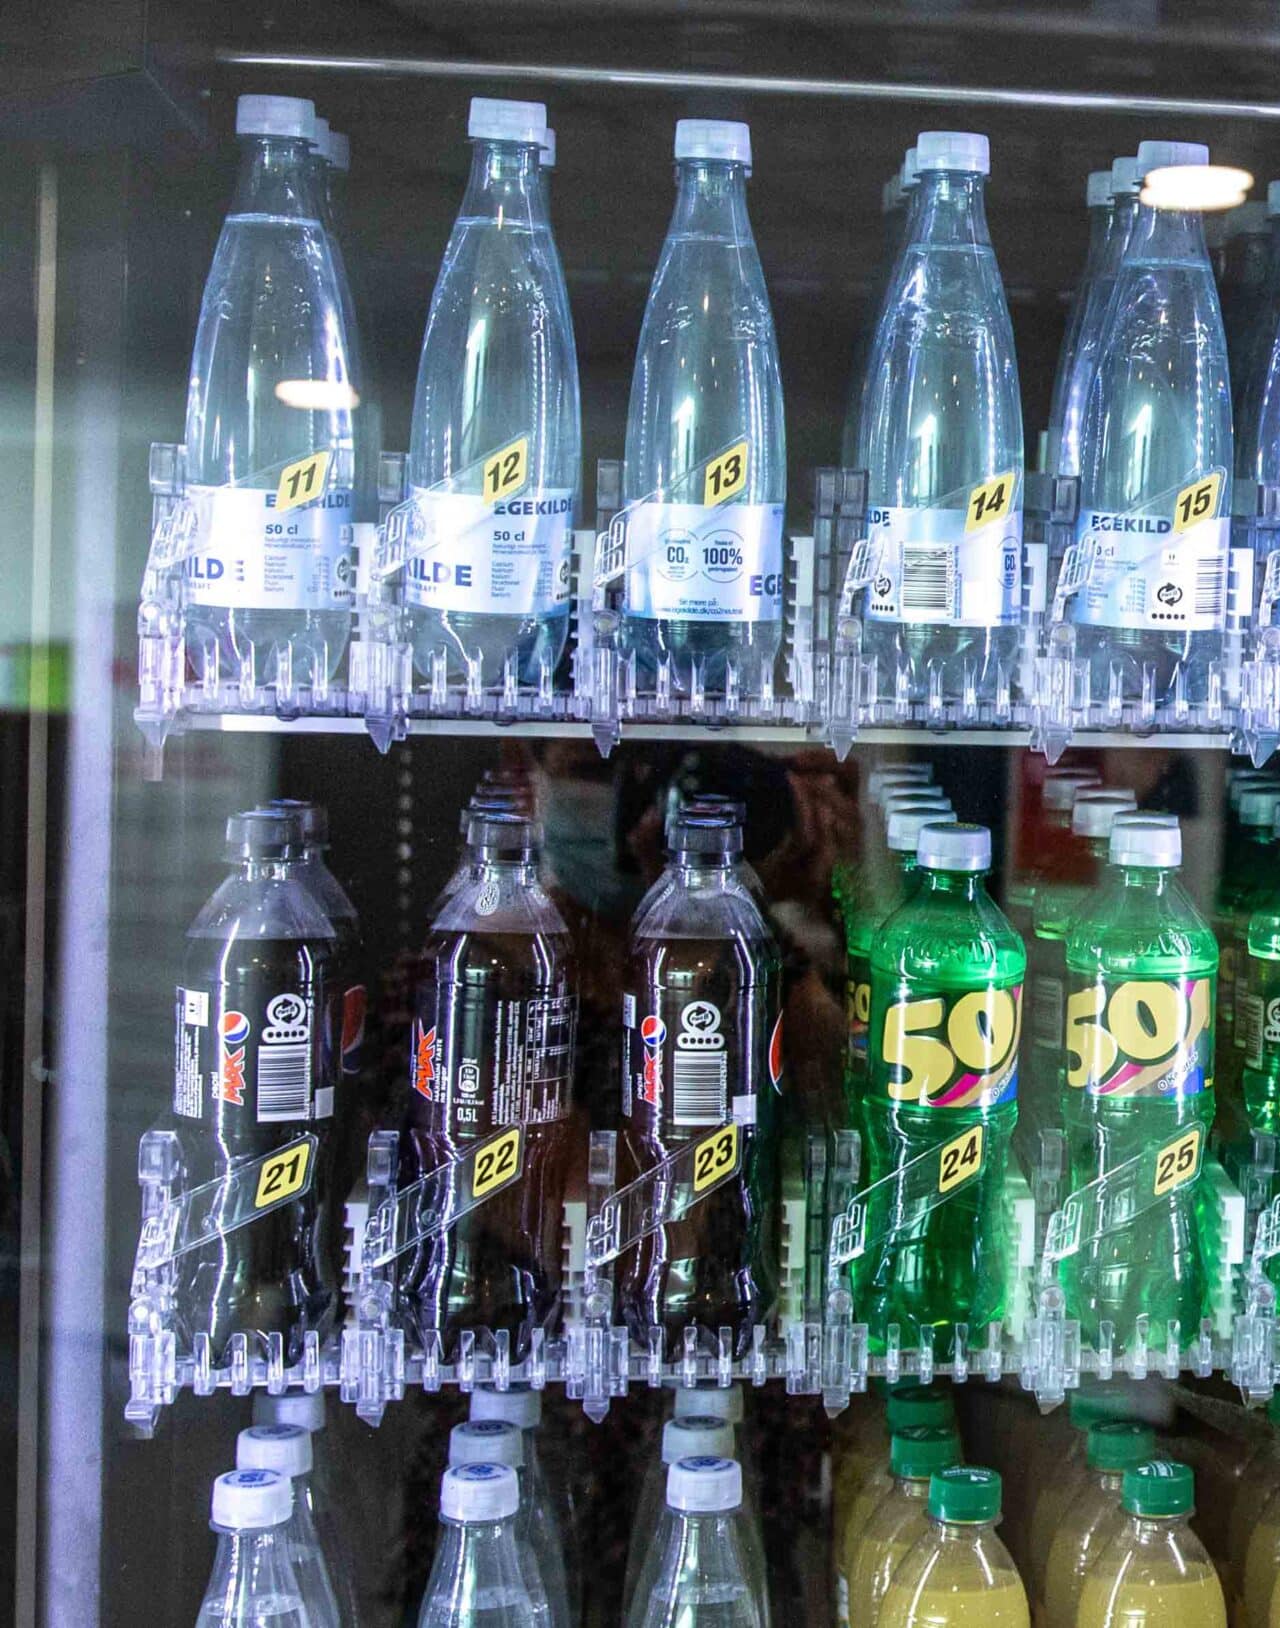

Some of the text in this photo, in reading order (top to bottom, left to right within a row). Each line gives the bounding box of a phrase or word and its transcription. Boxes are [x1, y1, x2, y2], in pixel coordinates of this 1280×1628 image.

[286, 463, 318, 499] 11
[487, 451, 521, 493] 12
[709, 454, 742, 496] 13
[972, 483, 1006, 521] 14
[1179, 484, 1212, 522] 15
[265, 523, 298, 535] 50 cl
[493, 530, 525, 541] 50 cl
[702, 547, 743, 565] 100%
[262, 1153, 301, 1196] 21
[476, 1140, 515, 1184] 22
[697, 1132, 734, 1181] 23
[942, 1134, 978, 1184] 24
[1157, 1139, 1194, 1186] 25
